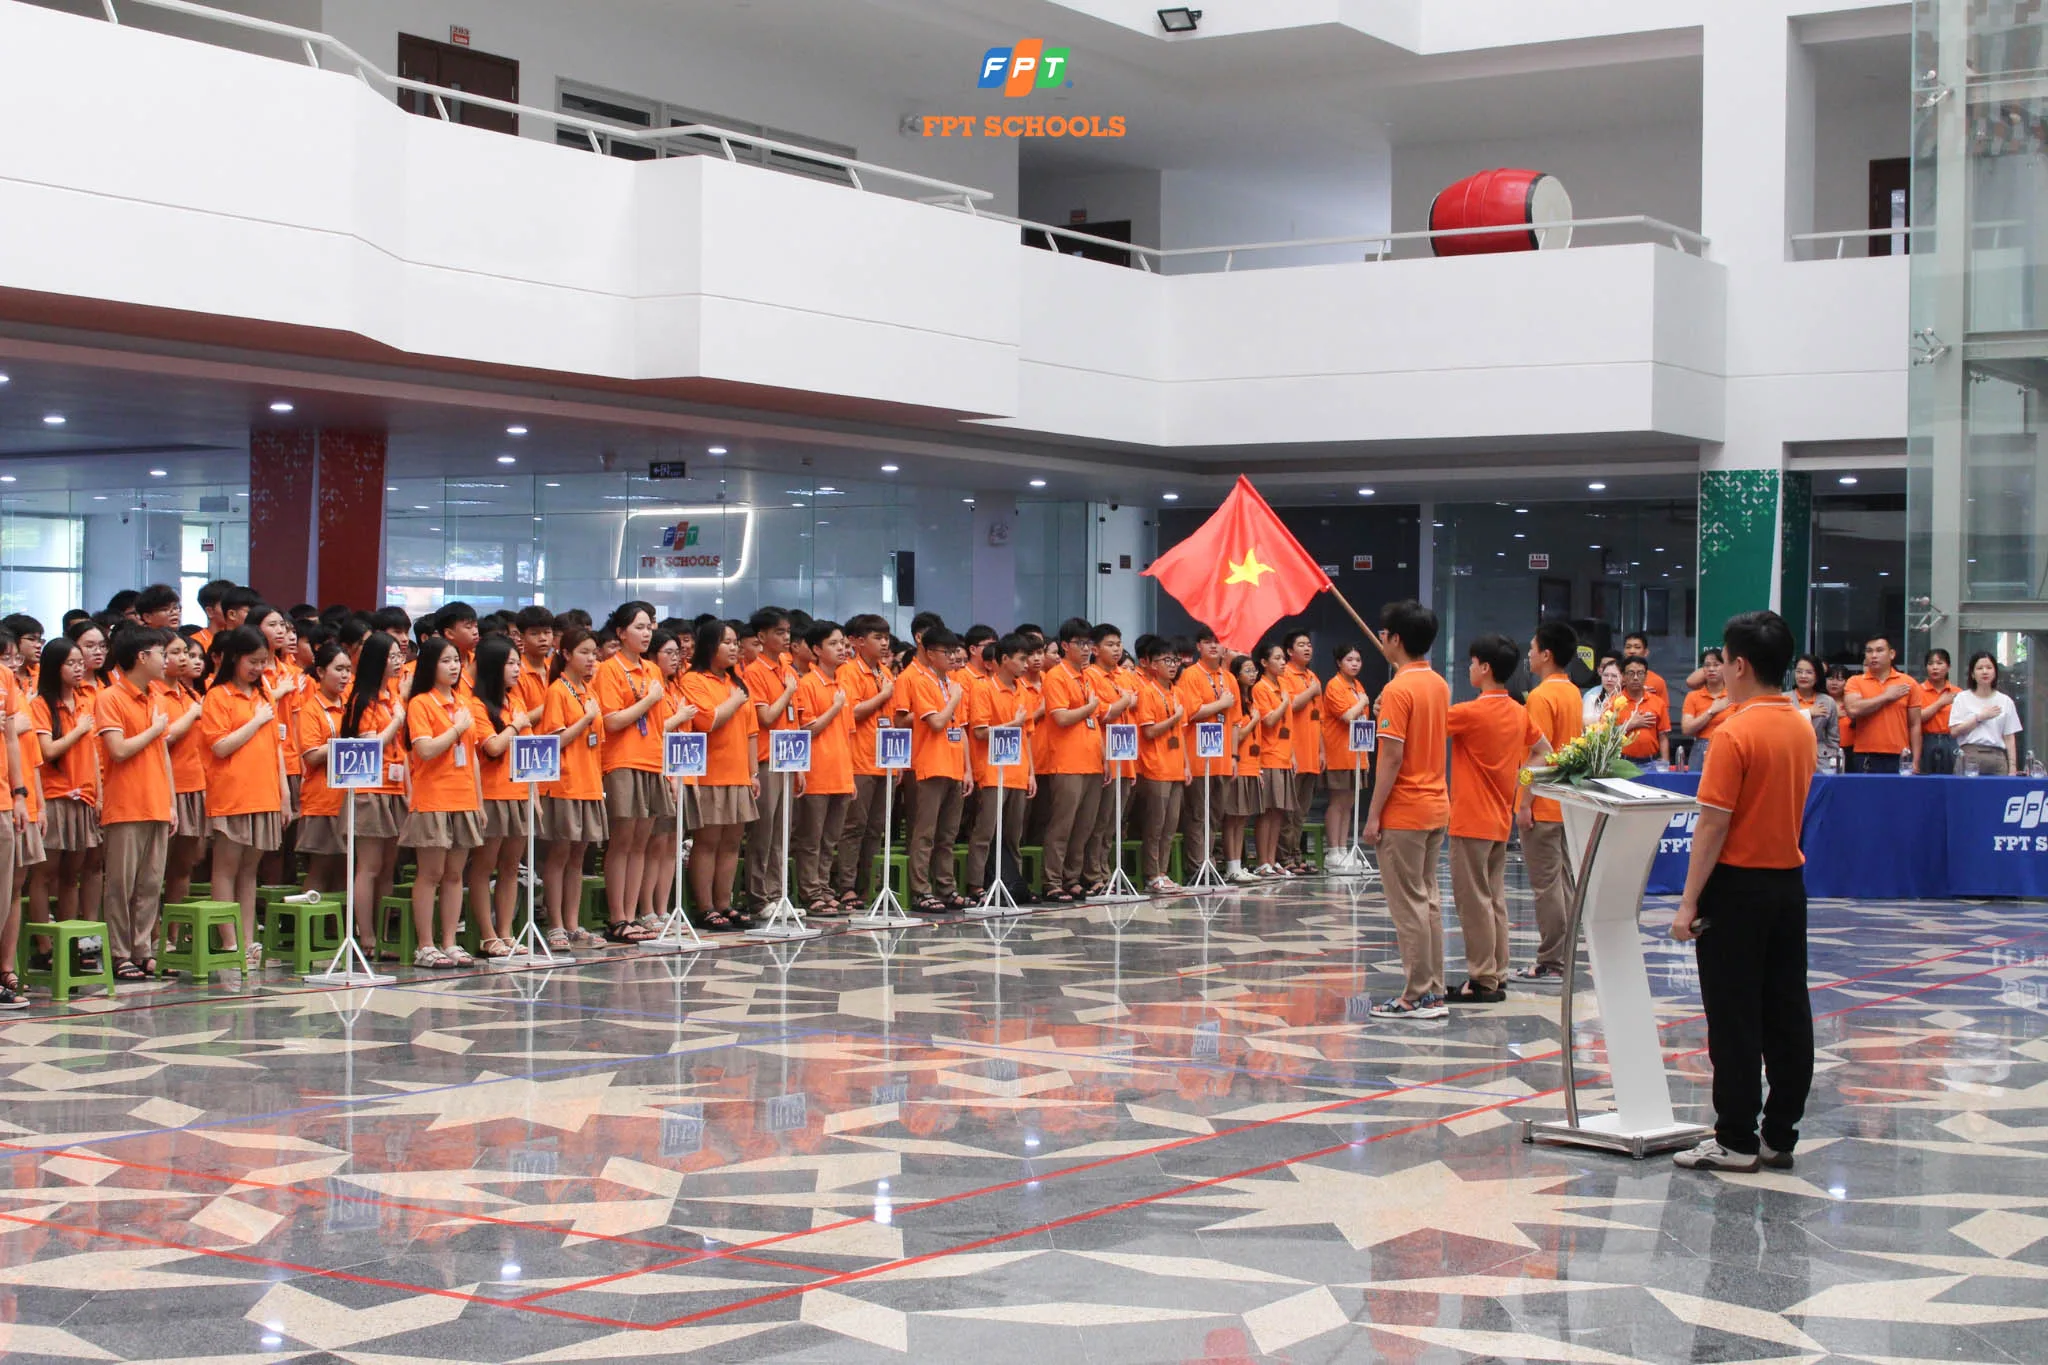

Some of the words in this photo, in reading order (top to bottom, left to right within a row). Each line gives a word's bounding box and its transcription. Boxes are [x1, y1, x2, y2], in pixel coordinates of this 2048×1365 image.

[665, 555, 721, 568] SCHOOLS
[779, 740, 806, 761] 11A2
[887, 738, 905, 758] 11A1
[995, 736, 1019, 756] 10A5
[1112, 733, 1136, 751] 10A4
[340, 750, 376, 775] 12A1
[520, 746, 553, 770] 11A4
[672, 743, 701, 765] 11A3
[1994, 836, 2031, 851] FPT
